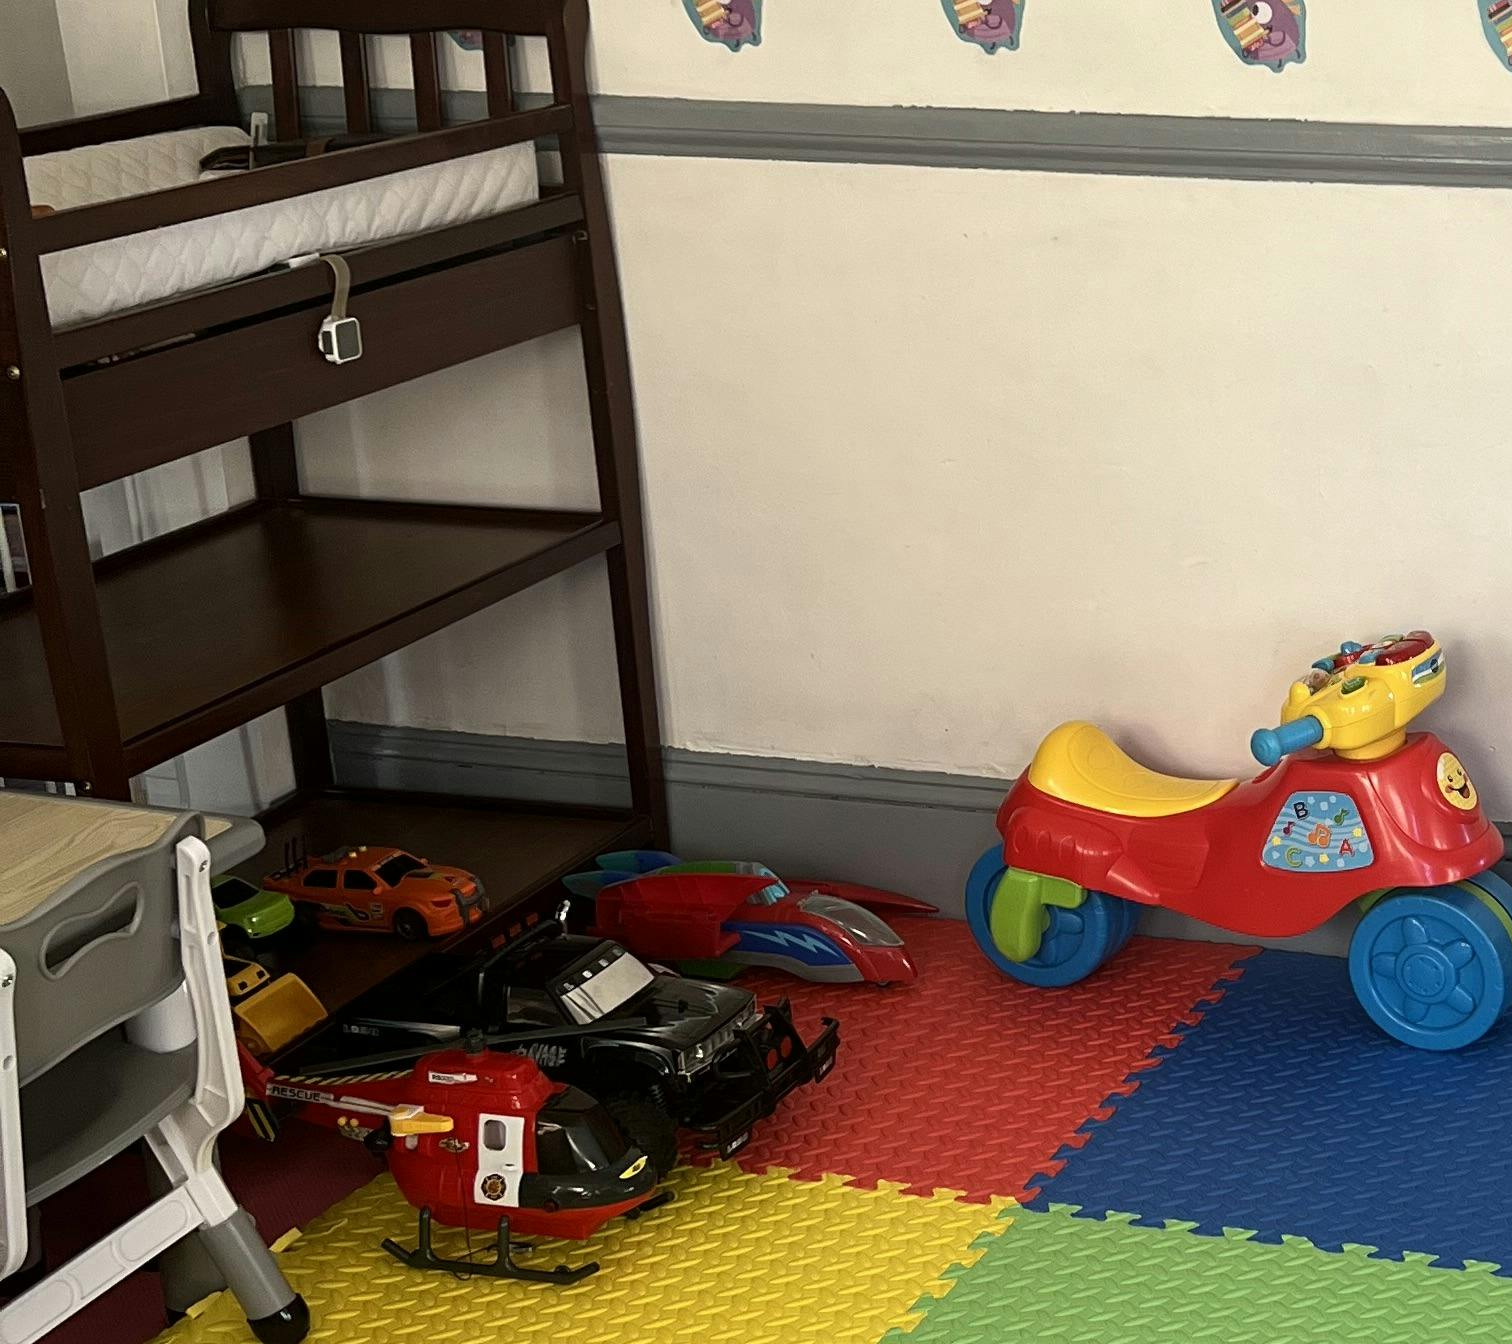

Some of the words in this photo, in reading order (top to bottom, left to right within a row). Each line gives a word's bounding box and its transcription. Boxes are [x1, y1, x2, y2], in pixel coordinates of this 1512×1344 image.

[1293, 802, 1308, 820] B
[1339, 838, 1355, 857] A
[1284, 847, 1303, 868] C
[271, 1086, 321, 1102] RESCUE
